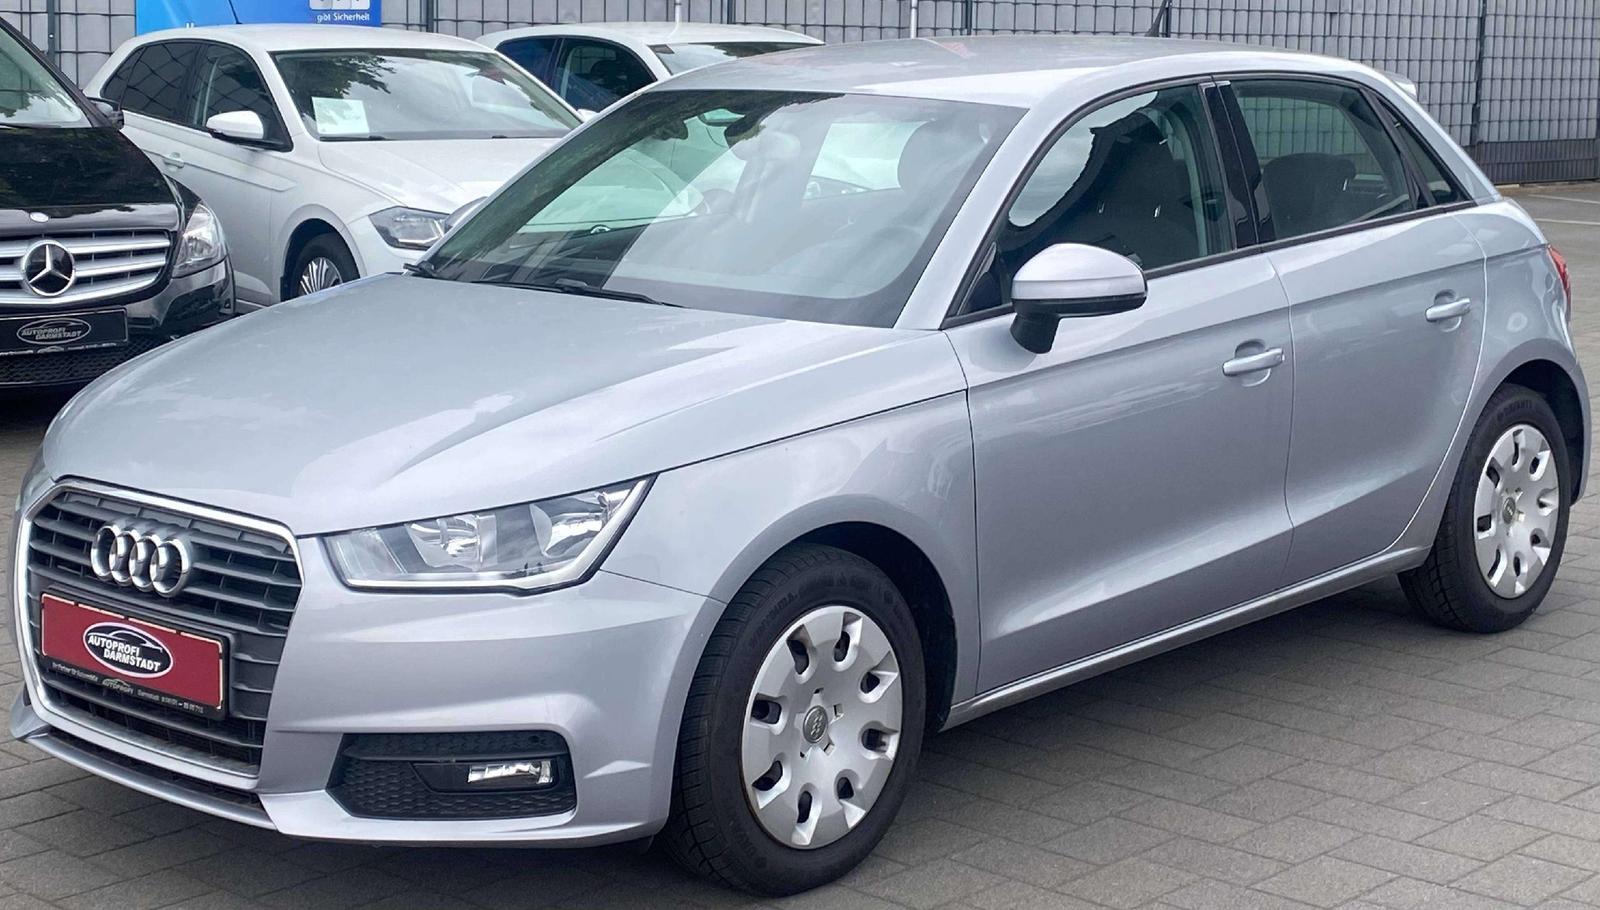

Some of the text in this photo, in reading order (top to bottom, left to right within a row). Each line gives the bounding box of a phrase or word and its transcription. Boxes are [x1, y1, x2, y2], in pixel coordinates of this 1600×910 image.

[334, 12, 370, 21] Sicherheit
[87, 635, 140, 656] AUTOPROFI
[103, 648, 161, 672] DARMSTADT
